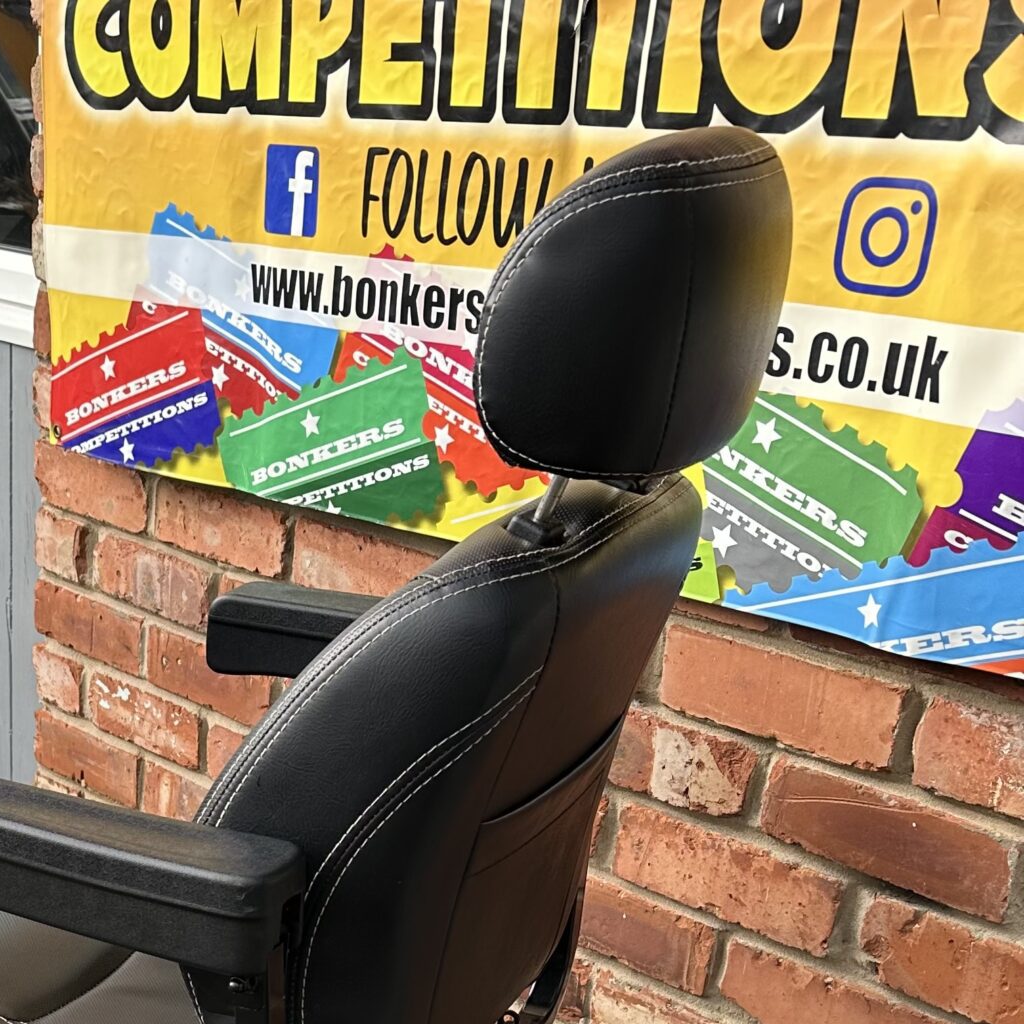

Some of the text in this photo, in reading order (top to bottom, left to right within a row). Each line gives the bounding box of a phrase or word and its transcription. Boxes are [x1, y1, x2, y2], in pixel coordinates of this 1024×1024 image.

[361, 146, 554, 248] FOLLOW
[165, 270, 303, 375] BONKERS
[65, 360, 187, 426] BONKERS
[251, 418, 406, 486] BONKERS
